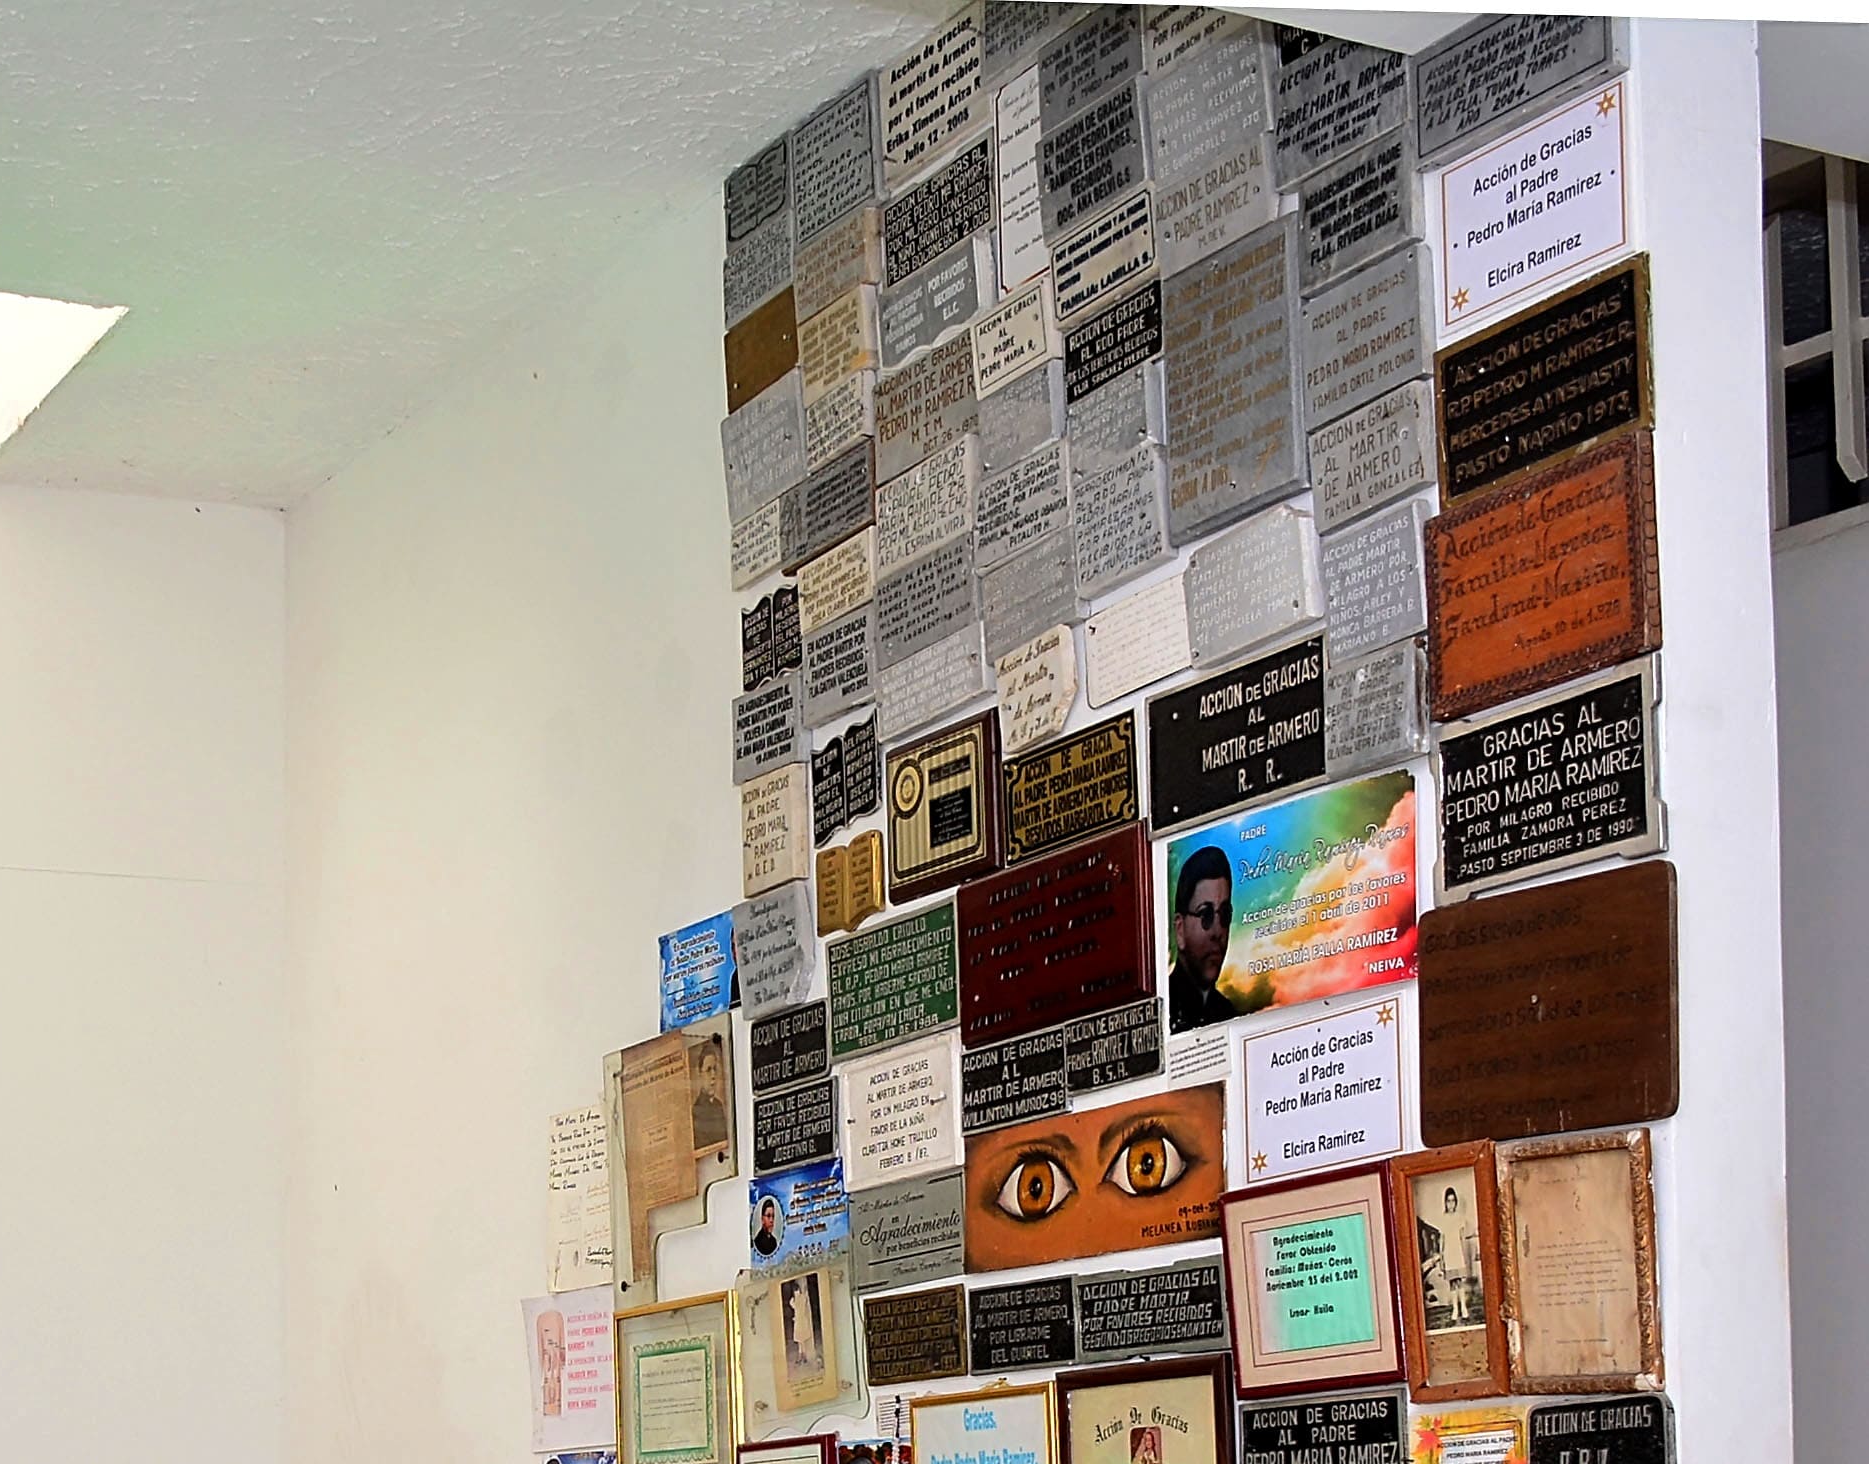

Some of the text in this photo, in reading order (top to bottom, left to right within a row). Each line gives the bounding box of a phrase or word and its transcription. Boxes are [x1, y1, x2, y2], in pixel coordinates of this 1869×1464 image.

[923, 45, 934, 59] de
[937, 17, 972, 51] gracias
[900, 71, 926, 100] martir
[929, 62, 939, 78] de
[942, 37, 976, 69] Armero
[905, 102, 913, 118] el
[916, 85, 939, 113] favor
[942, 57, 979, 92] recibido
[887, 129, 909, 153] Erika
[1473, 125, 1592, 196] Acción de Gracias
[1506, 168, 1558, 204] al Padre
[1467, 220, 1503, 248] Pedro
[1487, 233, 1582, 288] Elcira Ramirez
[1199, 654, 1320, 720] ACCION DE GRACIAS
[1248, 706, 1266, 726] AL
[1484, 702, 1602, 757] GRACIAS AL
[1202, 708, 1320, 772] MARTIR DE ARMERO
[1447, 716, 1641, 796] MARTIR DE ARMERO
[1238, 758, 1282, 792] R. R.
[1446, 745, 1643, 825] PEDRO MARIA RAMIREZ
[1463, 797, 1627, 858] FAMILIA ZAMORA PEREZ
[1467, 781, 1619, 838] POR MILAGRO RECIBIDO
[1240, 825, 1267, 841] PADRE
[1459, 819, 1633, 877] PASTO SEPTIEMBRE 3 DE 1990
[1248, 958, 1274, 976] ROSA
[1312, 940, 1344, 956] FALLA
[1369, 956, 1405, 974] NEIVA
[963, 1033, 1063, 1073] ACCION DE GRACIAS
[1270, 1030, 1374, 1068] Acción de Gracias
[964, 1069, 1065, 1107] MARTIR DE ARMERO
[1298, 1061, 1344, 1084] al Padre
[1266, 1097, 1298, 1116] Pedro
[1334, 1077, 1382, 1100] Ramirez
[962, 1105, 1013, 1128] WILLINTON
[1284, 1130, 1365, 1159] Elcira Ramirez
[1253, 1402, 1388, 1429] ACCION DE GRACIAS
[1278, 1424, 1356, 1446] AL PADRE
